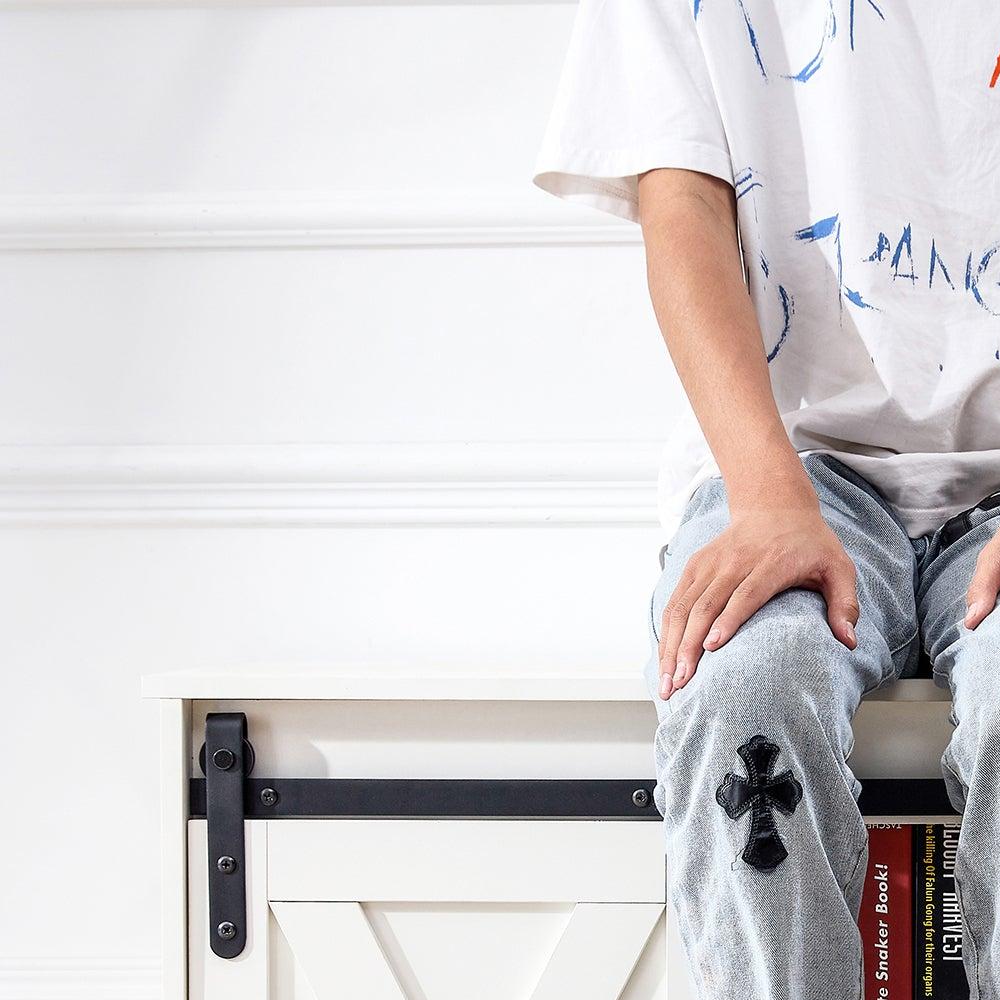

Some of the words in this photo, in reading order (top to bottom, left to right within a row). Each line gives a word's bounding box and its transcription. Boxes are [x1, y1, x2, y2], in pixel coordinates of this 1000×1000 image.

[923, 835, 936, 864] killing
[874, 863, 889, 914] Book!
[925, 877, 936, 902] Falun
[923, 903, 936, 927] Gong
[925, 928, 936, 941] for
[874, 920, 889, 981] Snaker
[925, 943, 936, 964] their
[922, 966, 933, 997] organs
